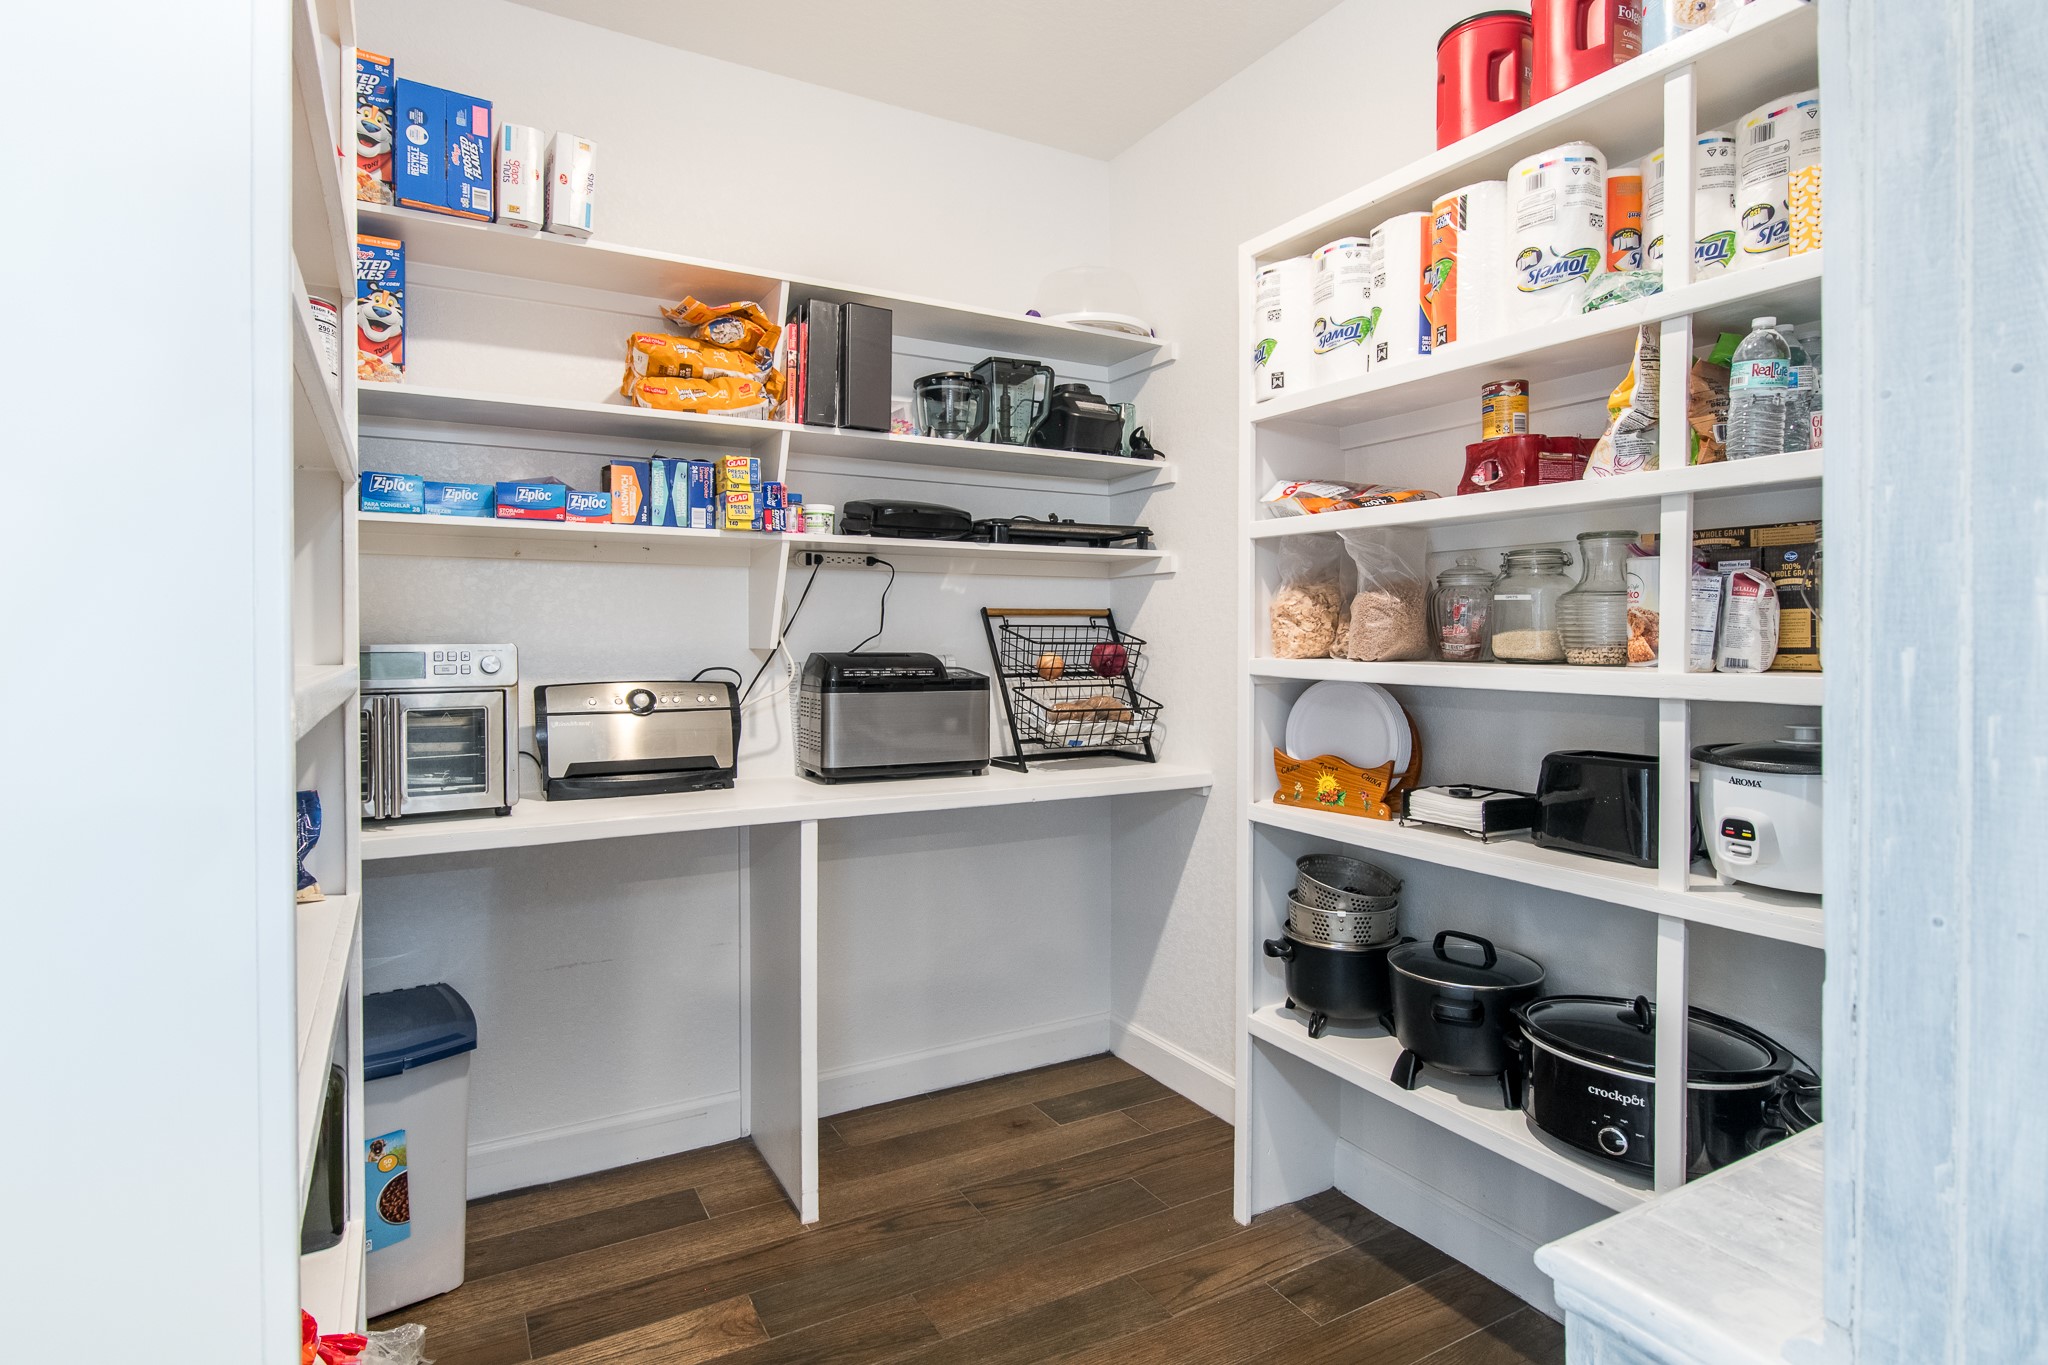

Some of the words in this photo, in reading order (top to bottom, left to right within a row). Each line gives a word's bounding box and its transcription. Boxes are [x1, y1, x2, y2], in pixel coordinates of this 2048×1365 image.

[363, 159, 380, 171] TONY
[411, 146, 420, 176] RECYCLE
[420, 152, 429, 175] READY
[460, 135, 474, 181] FROSTED
[468, 142, 483, 181] FLAKES
[509, 160, 521, 185] grape
[1757, 220, 1788, 244] els
[1695, 238, 1729, 261] Tow
[357, 260, 391, 271] STED
[1527, 254, 1589, 285] Towels
[357, 270, 385, 280] KES
[318, 324, 331, 333] 290
[1319, 322, 1362, 348] Towels
[374, 343, 390, 355] TONY
[692, 465, 698, 474] 24
[727, 459, 746, 467] GLAD
[373, 476, 414, 493] Ziploc
[444, 488, 479, 502] Ziploc
[518, 488, 552, 503] Ziploc
[621, 474, 629, 517] SANDWICH
[728, 494, 748, 502] GLAD
[380, 501, 410, 509] CONGELAR
[570, 495, 607, 511] Ziploc
[1700, 530, 1722, 538] WHOLE
[1723, 529, 1745, 538] GRAIN
[1793, 569, 1814, 577] GRAN
[1361, 772, 1382, 788] CHINA
[1728, 776, 1762, 788] AROMA
